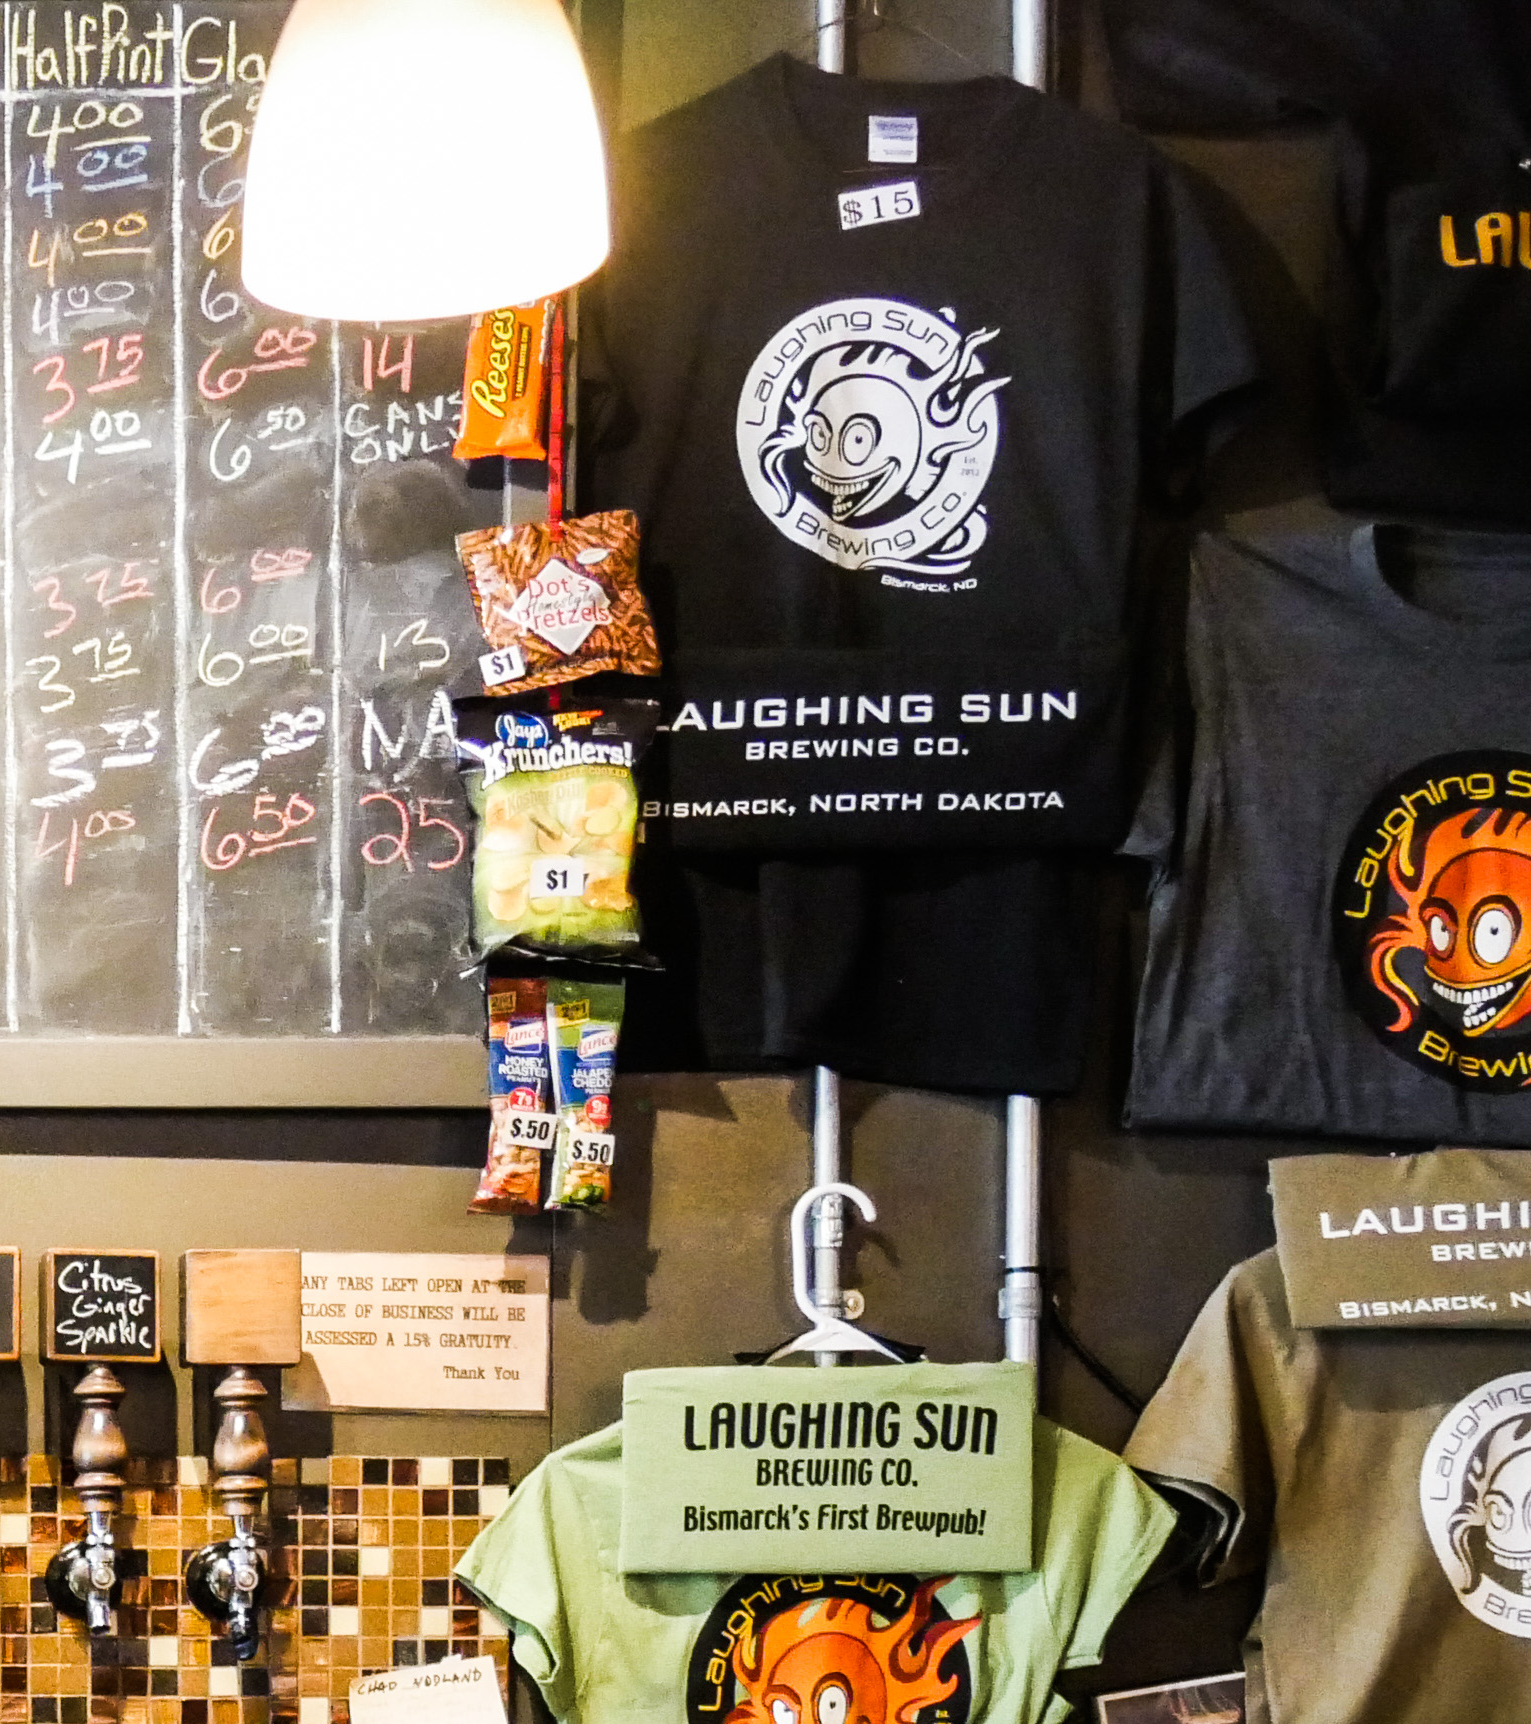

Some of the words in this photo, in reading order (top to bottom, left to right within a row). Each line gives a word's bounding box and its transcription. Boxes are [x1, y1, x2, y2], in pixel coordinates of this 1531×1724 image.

[842, 191, 915, 225] $15
[363, 333, 413, 392] 14
[745, 308, 871, 427] Laughing
[882, 308, 957, 357] Sun
[795, 511, 915, 558] Brewing
[933, 491, 968, 528] Co.
[527, 575, 590, 600] Dot's
[518, 600, 609, 629] Pretzels
[492, 653, 515, 675] $1
[960, 691, 1077, 723] SUN
[482, 734, 634, 790] Krunchers!
[746, 739, 898, 760] BREWING
[913, 737, 969, 756] CO.
[810, 793, 923, 812] NORTH
[938, 790, 1064, 810] DAKOTA
[359, 792, 465, 871] 25
[1344, 772, 1495, 918] Laughing
[547, 869, 568, 890] $1
[1418, 1030, 1531, 1077] Brewi
[510, 1118, 549, 1140] $.50
[572, 1140, 610, 1163] $.50
[58, 1261, 141, 1296] Citrus
[302, 1277, 328, 1290] ANY
[338, 1277, 373, 1291] TABS
[382, 1278, 417, 1292] LEFT
[428, 1279, 462, 1292] OPEN
[472, 1280, 490, 1293] AT
[498, 1280, 525, 1293] THE
[72, 1296, 151, 1317] Ginger
[301, 1303, 346, 1318] CLOSE
[355, 1305, 373, 1318] OF
[382, 1306, 453, 1320] BUSINESS
[463, 1307, 498, 1321] WILL
[508, 1308, 525, 1321] BE
[305, 1331, 376, 1345] ASSESSED
[386, 1333, 394, 1346] A
[404, 1333, 431, 1347] 15%
[443, 1366, 485, 1379] Thank
[495, 1367, 519, 1380] You
[684, 1401, 900, 1451] LAUGHING
[913, 1401, 998, 1455] SUN
[756, 1458, 872, 1486] BREWING
[880, 1458, 918, 1486] CO.
[684, 1504, 809, 1532] Bismarck's
[817, 1504, 868, 1531] First
[876, 1506, 986, 1537] Brewpub!
[358, 1681, 397, 1695] CHAD
